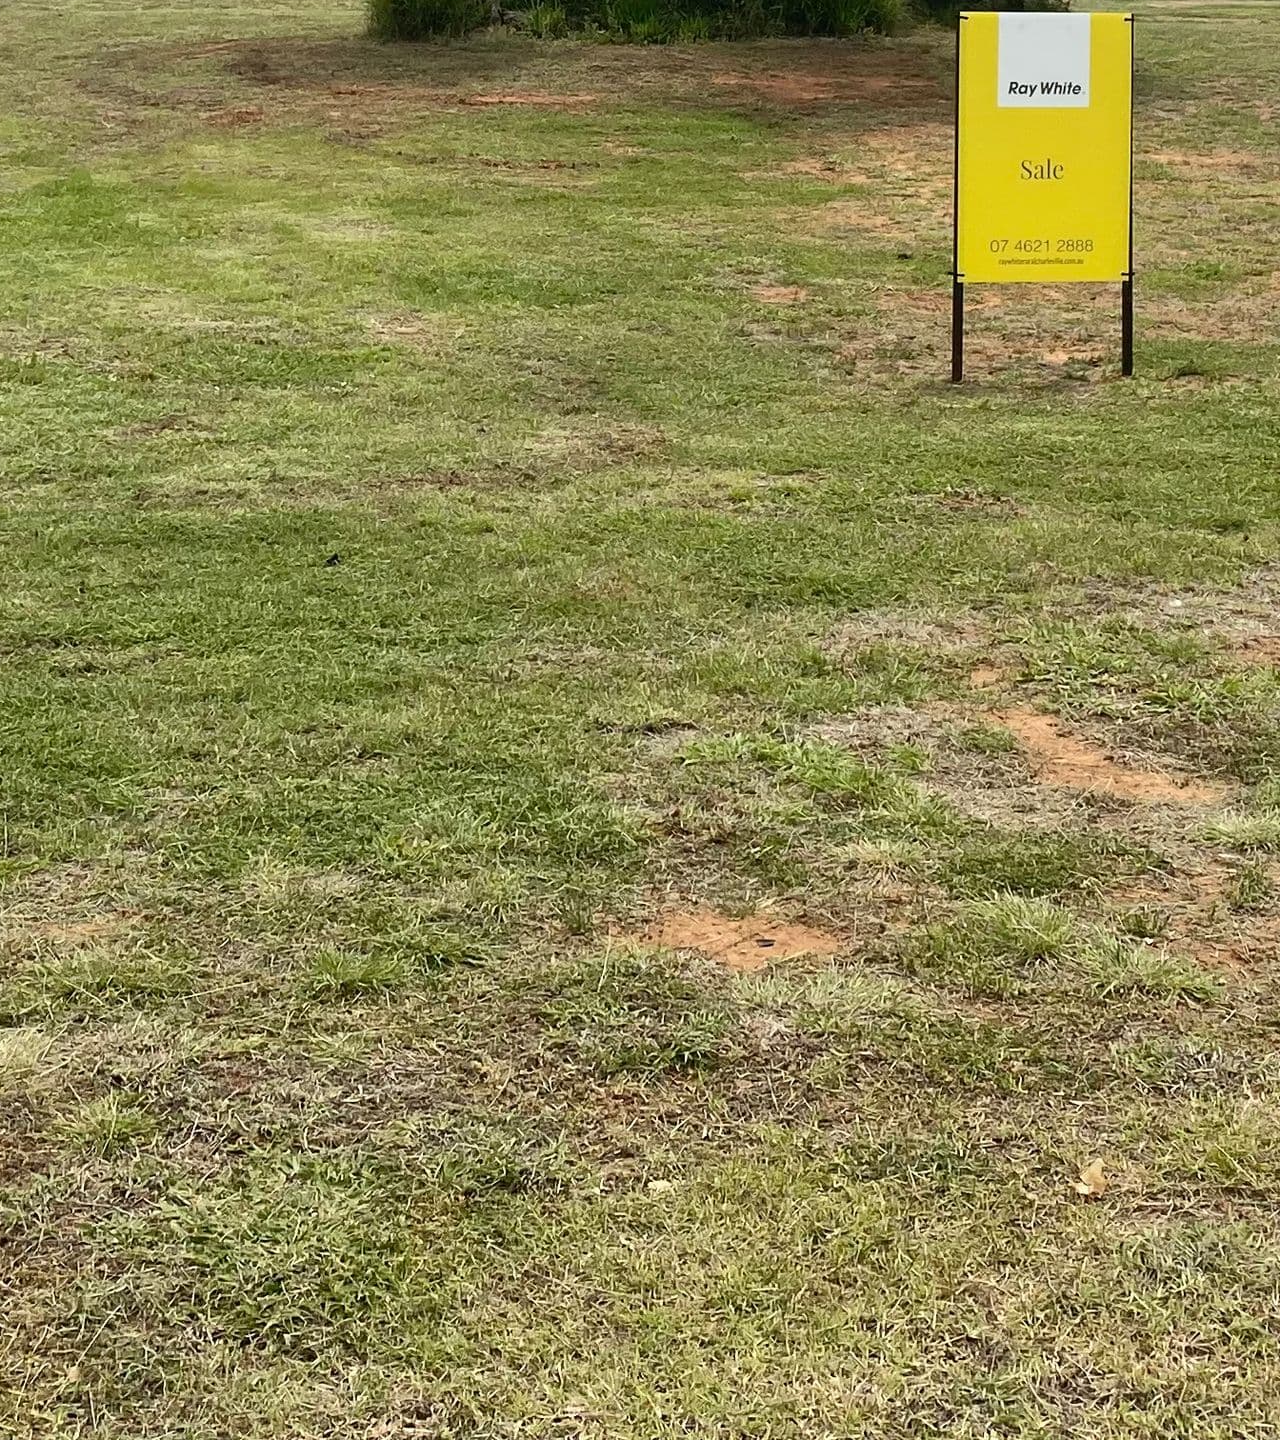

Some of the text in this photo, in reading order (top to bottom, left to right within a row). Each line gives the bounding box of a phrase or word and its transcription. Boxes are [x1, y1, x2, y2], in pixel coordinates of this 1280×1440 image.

[1008, 81, 1082, 98] Ray White
[1020, 158, 1065, 181] Sale
[989, 239, 1094, 253] 07 4621 2888
